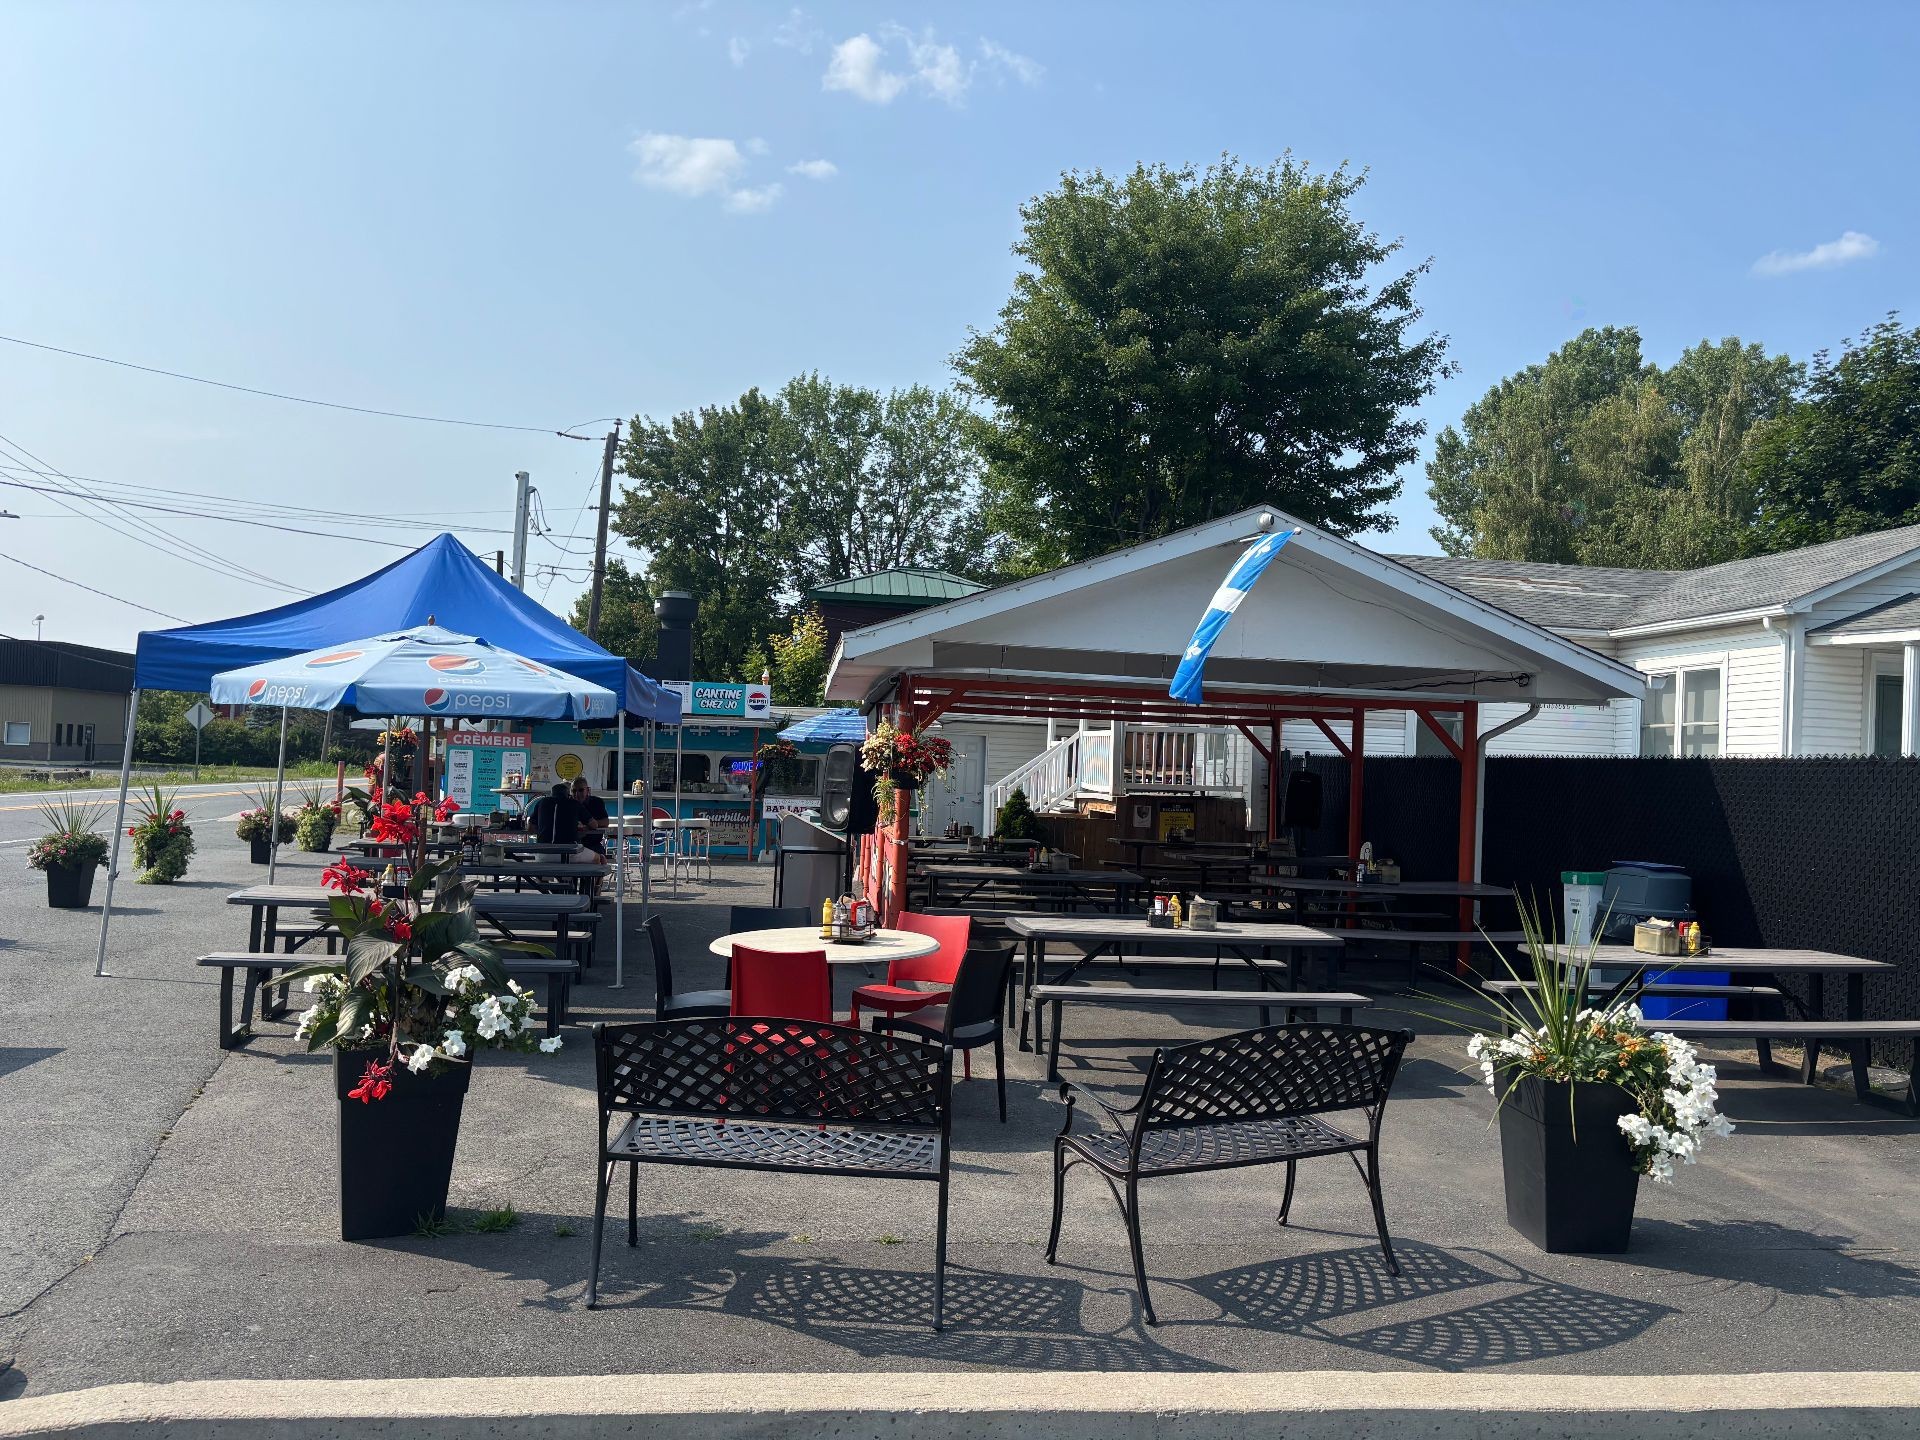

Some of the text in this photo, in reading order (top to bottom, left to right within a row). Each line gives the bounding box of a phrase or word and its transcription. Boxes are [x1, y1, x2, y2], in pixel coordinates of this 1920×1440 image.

[267, 684, 308, 701] pepsi
[695, 688, 743, 700] CANTINE
[455, 693, 511, 712] pepsi
[700, 700, 738, 710] CHEZ JO
[453, 732, 525, 747] CRÈMERIE
